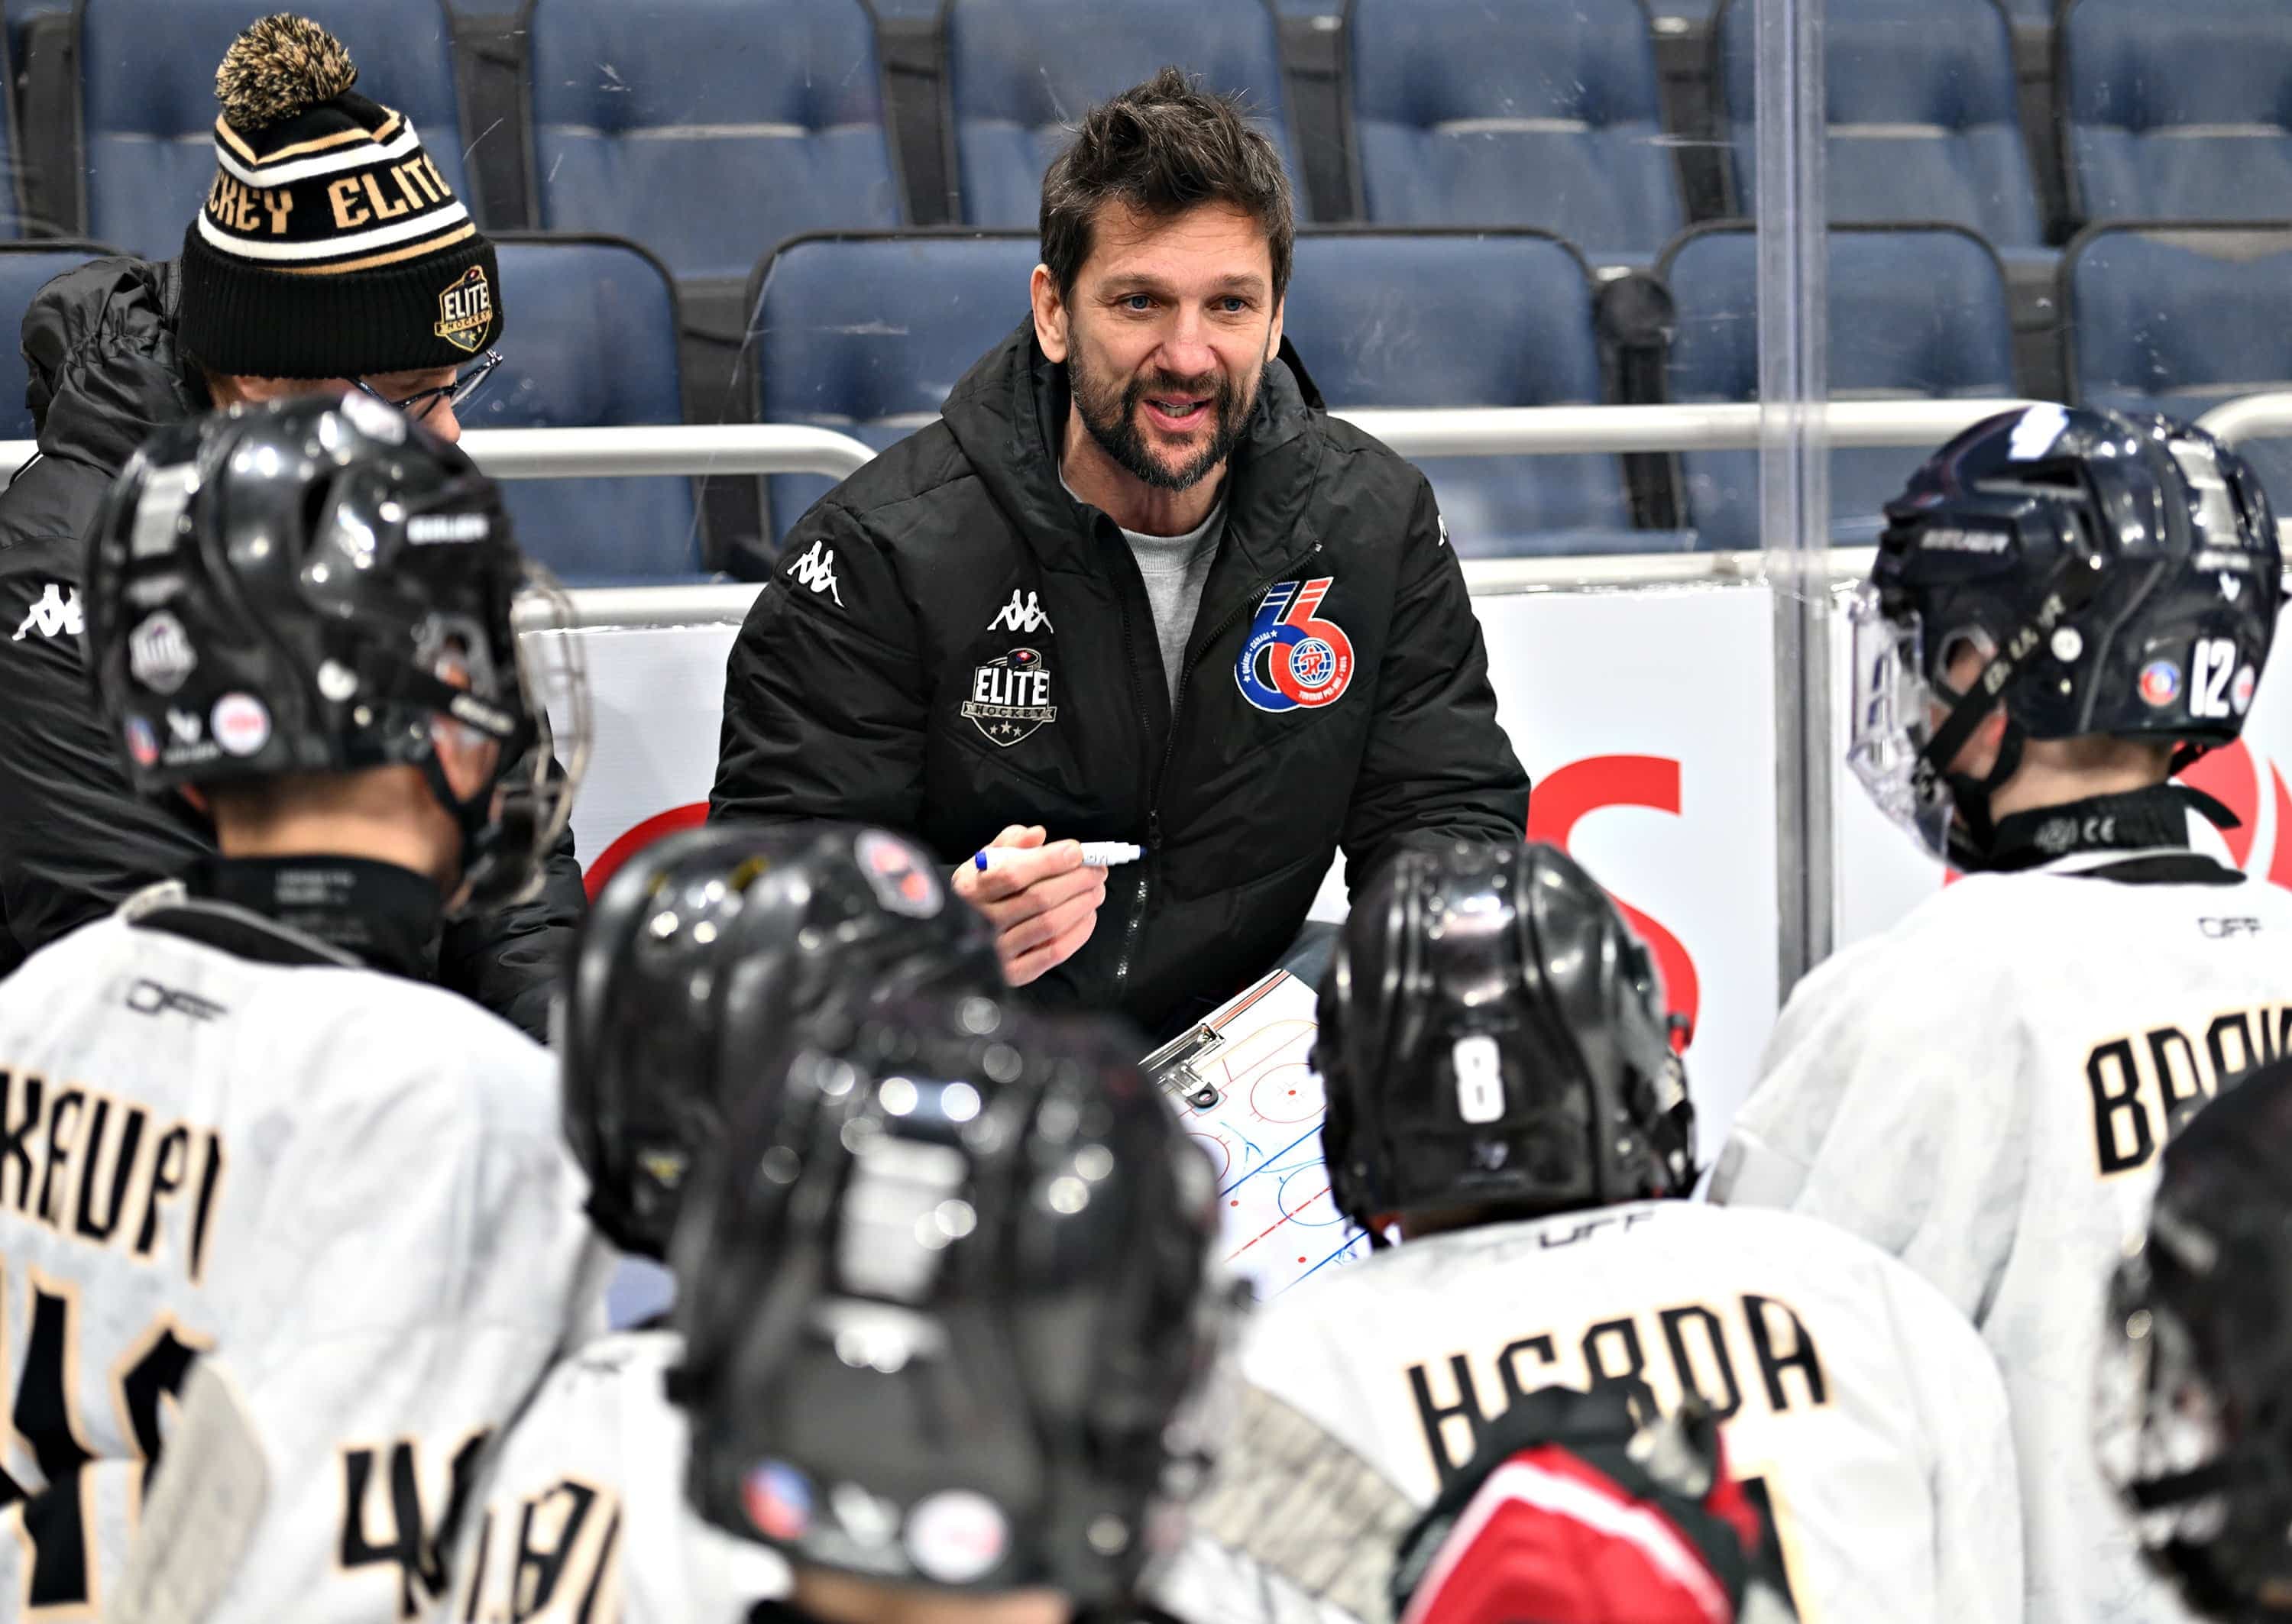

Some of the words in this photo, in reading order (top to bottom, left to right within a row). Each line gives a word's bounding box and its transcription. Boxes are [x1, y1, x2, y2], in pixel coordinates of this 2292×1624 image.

[444, 283, 490, 322] ELITE
[974, 668, 1050, 707] ELITE
[2190, 638, 2236, 719] 12
[977, 705, 1044, 717] HOCKEY
[1452, 1035, 1507, 1124] 8
